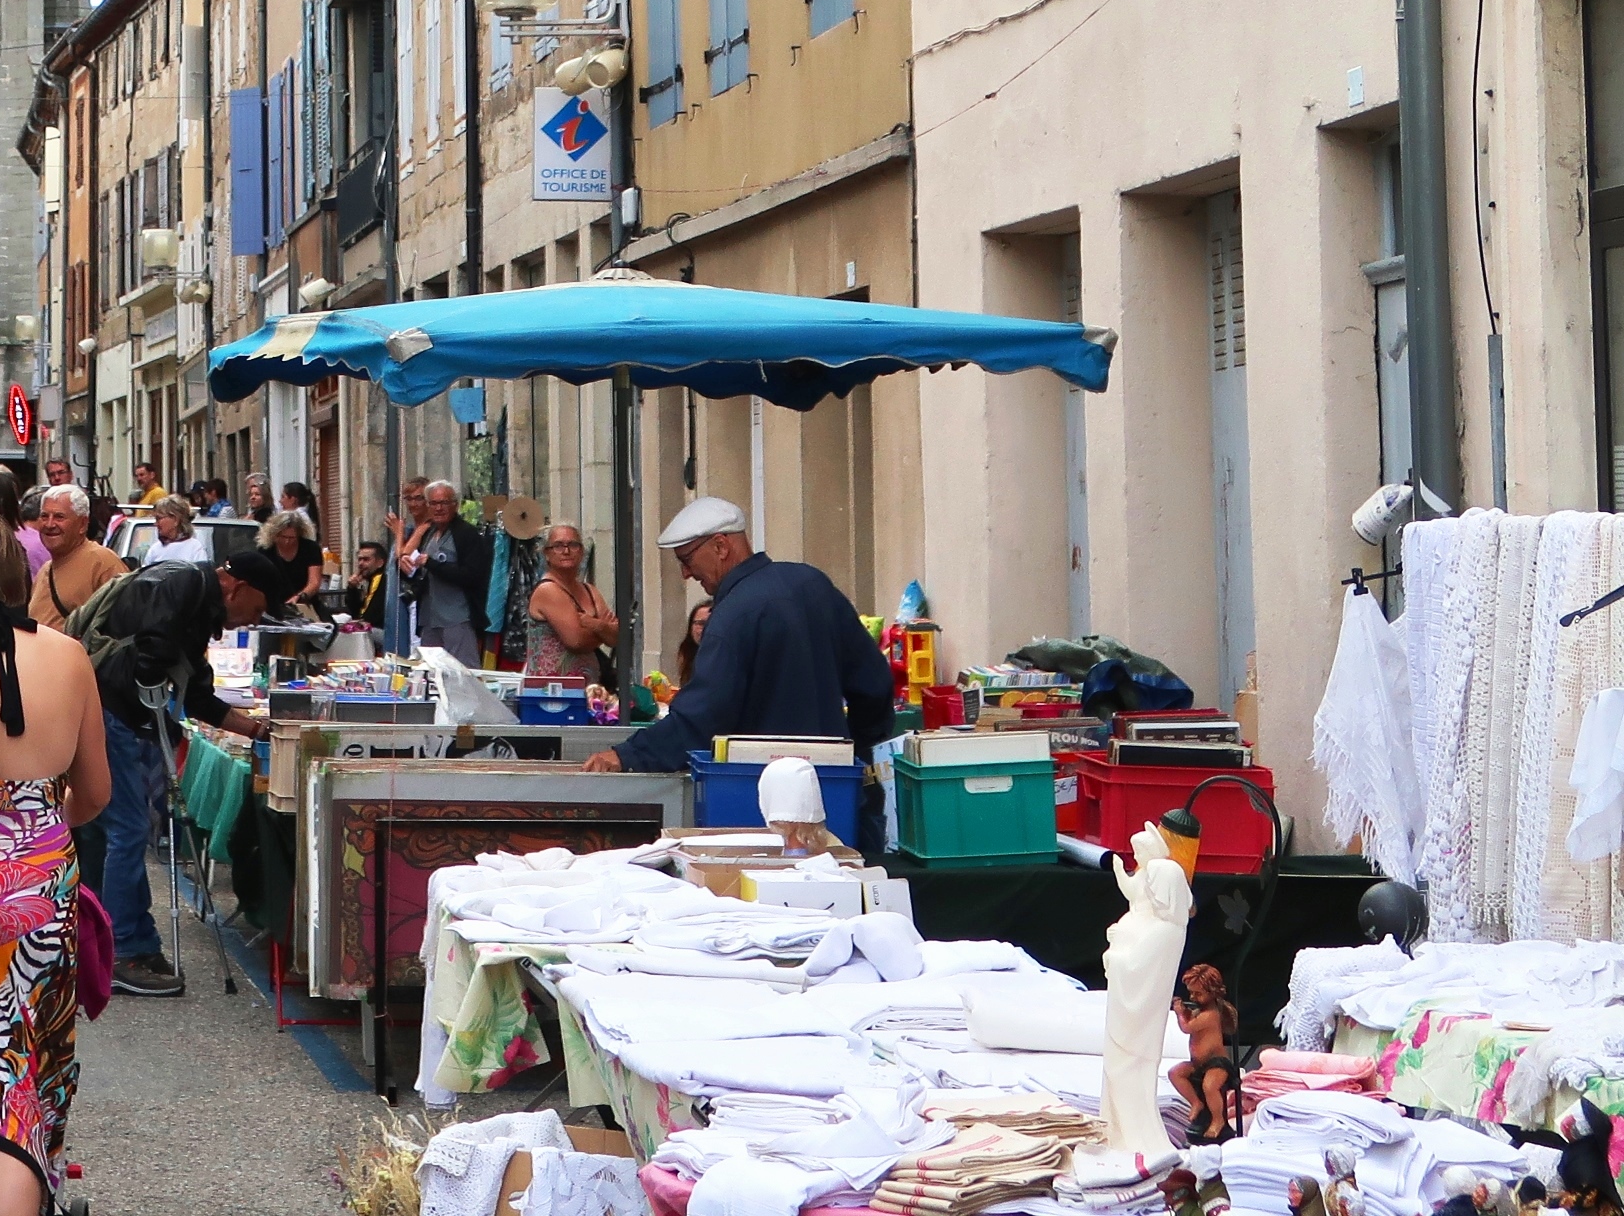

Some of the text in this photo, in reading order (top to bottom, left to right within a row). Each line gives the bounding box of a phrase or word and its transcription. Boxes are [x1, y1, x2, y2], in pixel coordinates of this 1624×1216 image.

[541, 169, 607, 179] OFFICE DE
[542, 182, 607, 193] TOURISME
[14, 396, 25, 433] TABAC
[872, 885, 880, 905] eram
